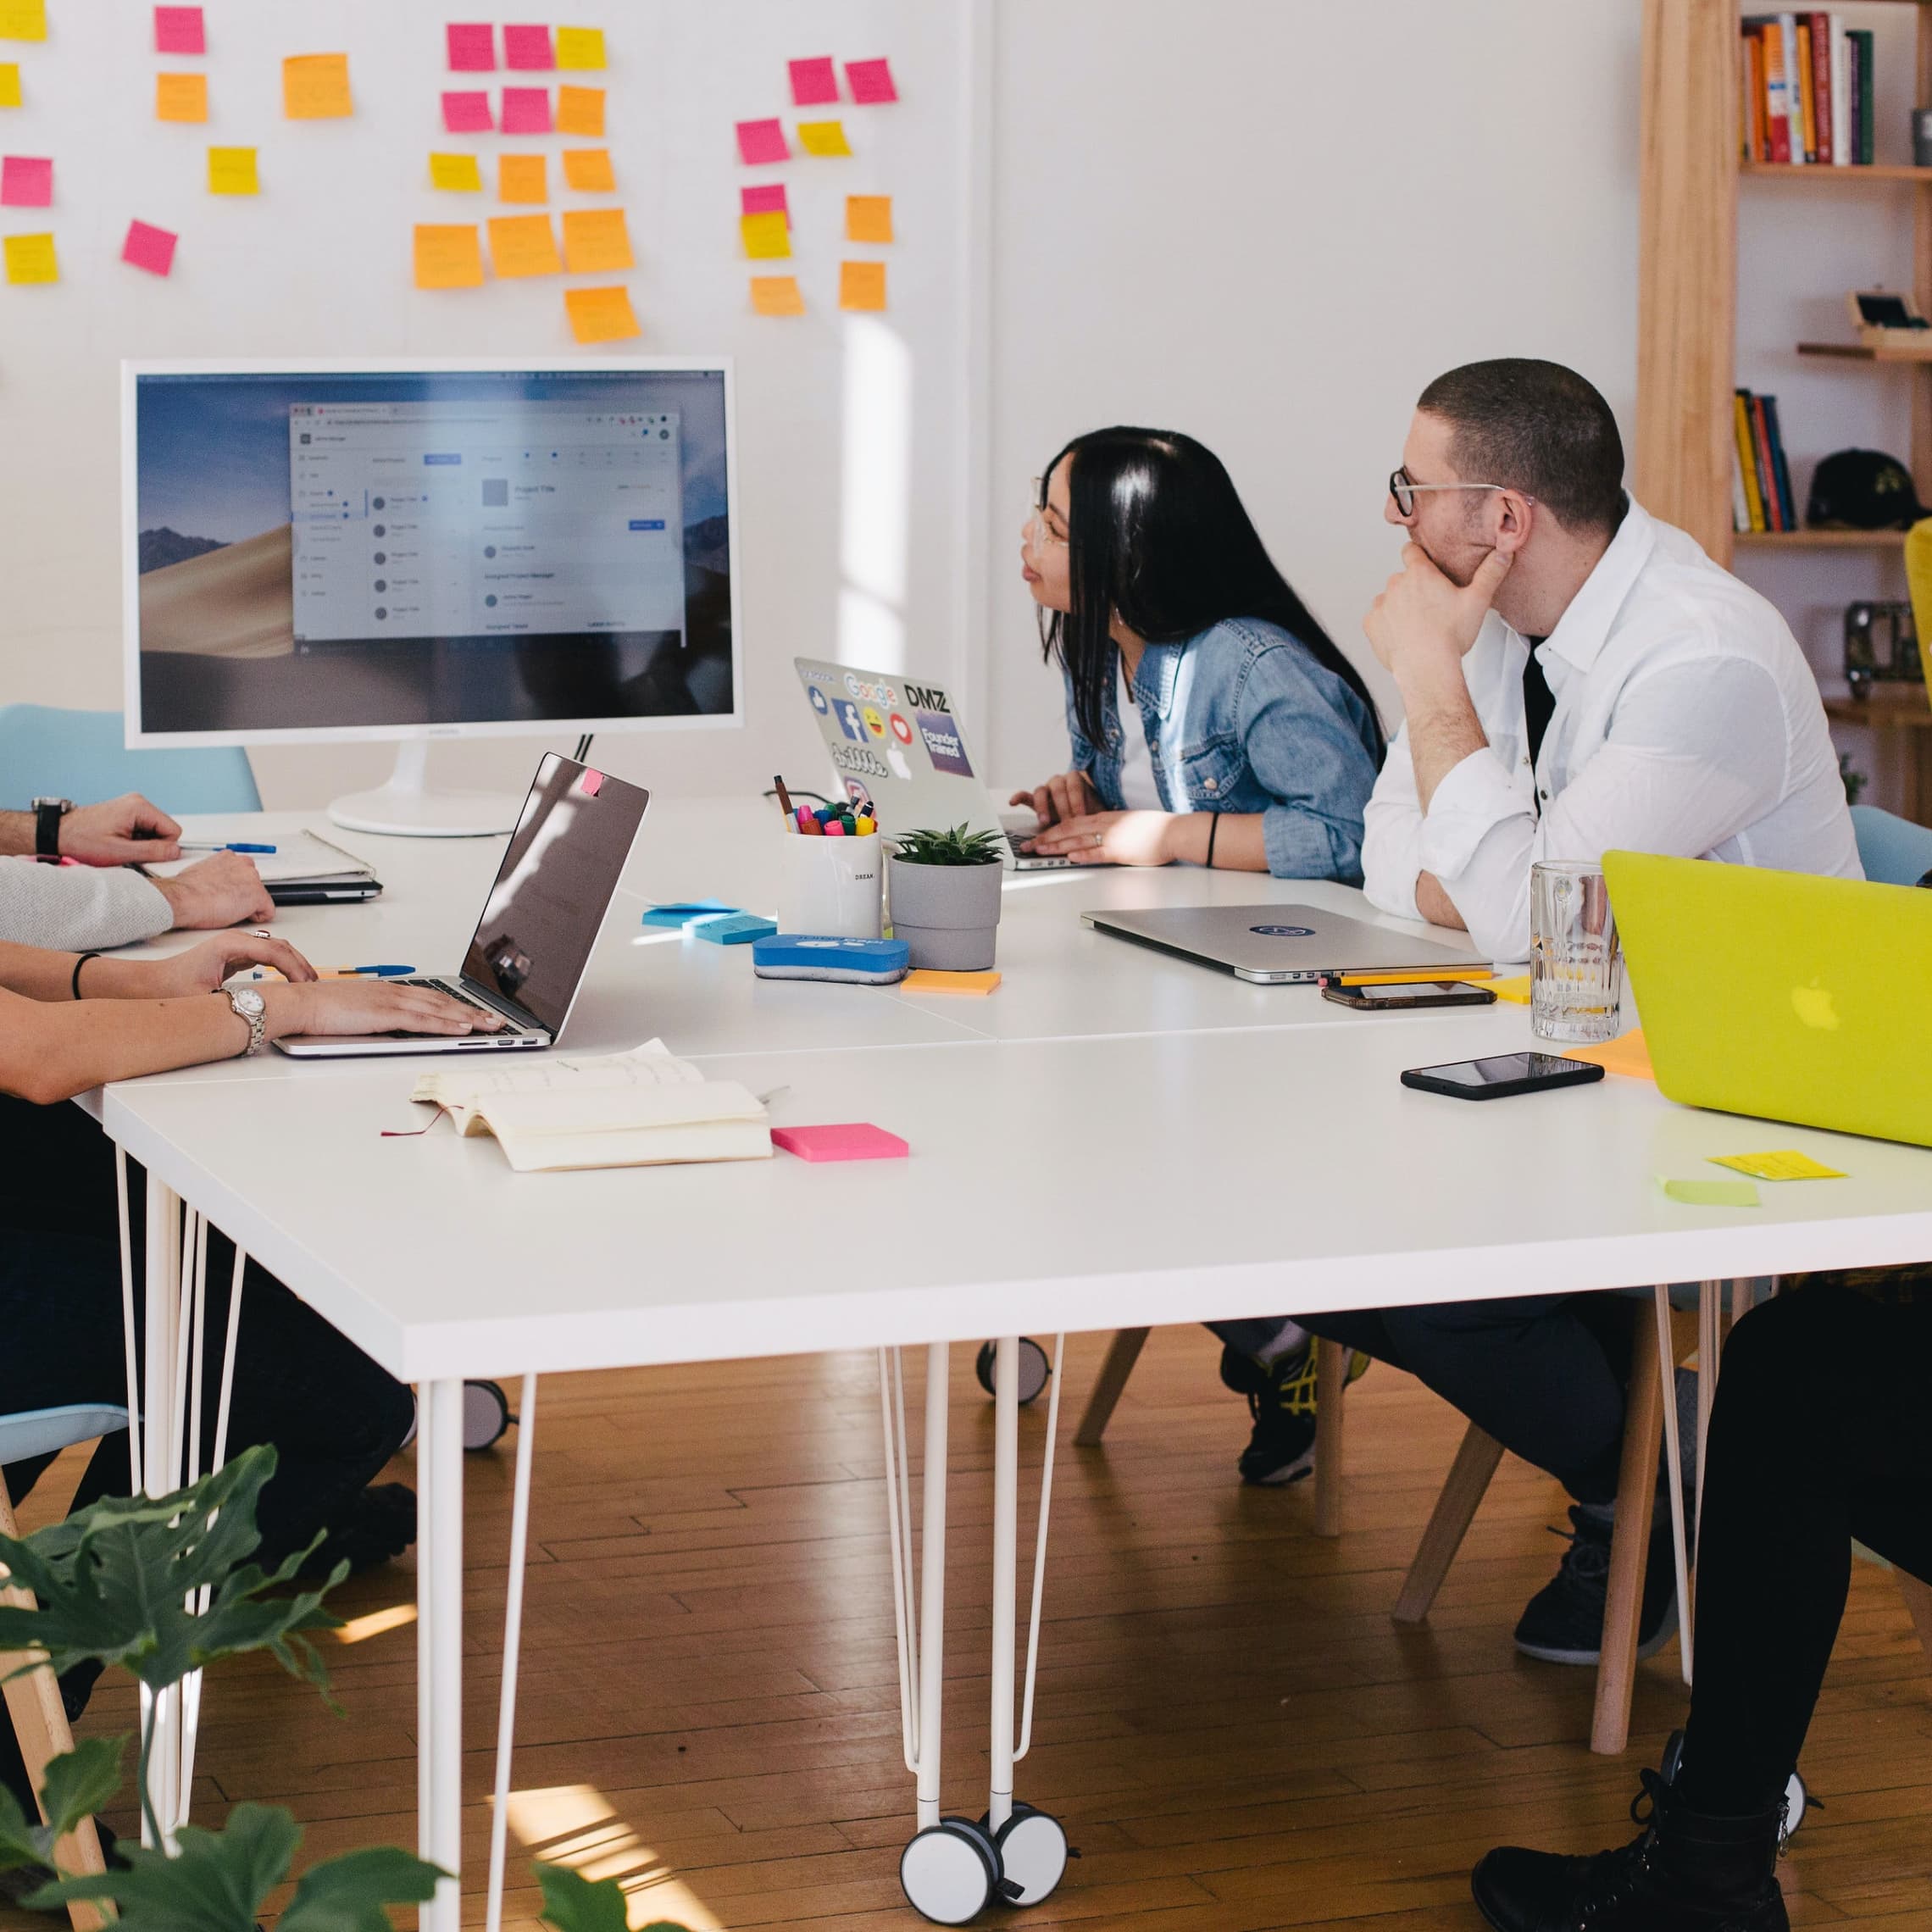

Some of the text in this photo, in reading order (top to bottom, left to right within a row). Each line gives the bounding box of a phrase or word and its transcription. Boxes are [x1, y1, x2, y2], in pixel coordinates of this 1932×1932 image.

[845, 674, 897, 708] Google
[903, 684, 951, 713] DMZ
[921, 728, 959, 747] Founder
[925, 740, 961, 758] Trained
